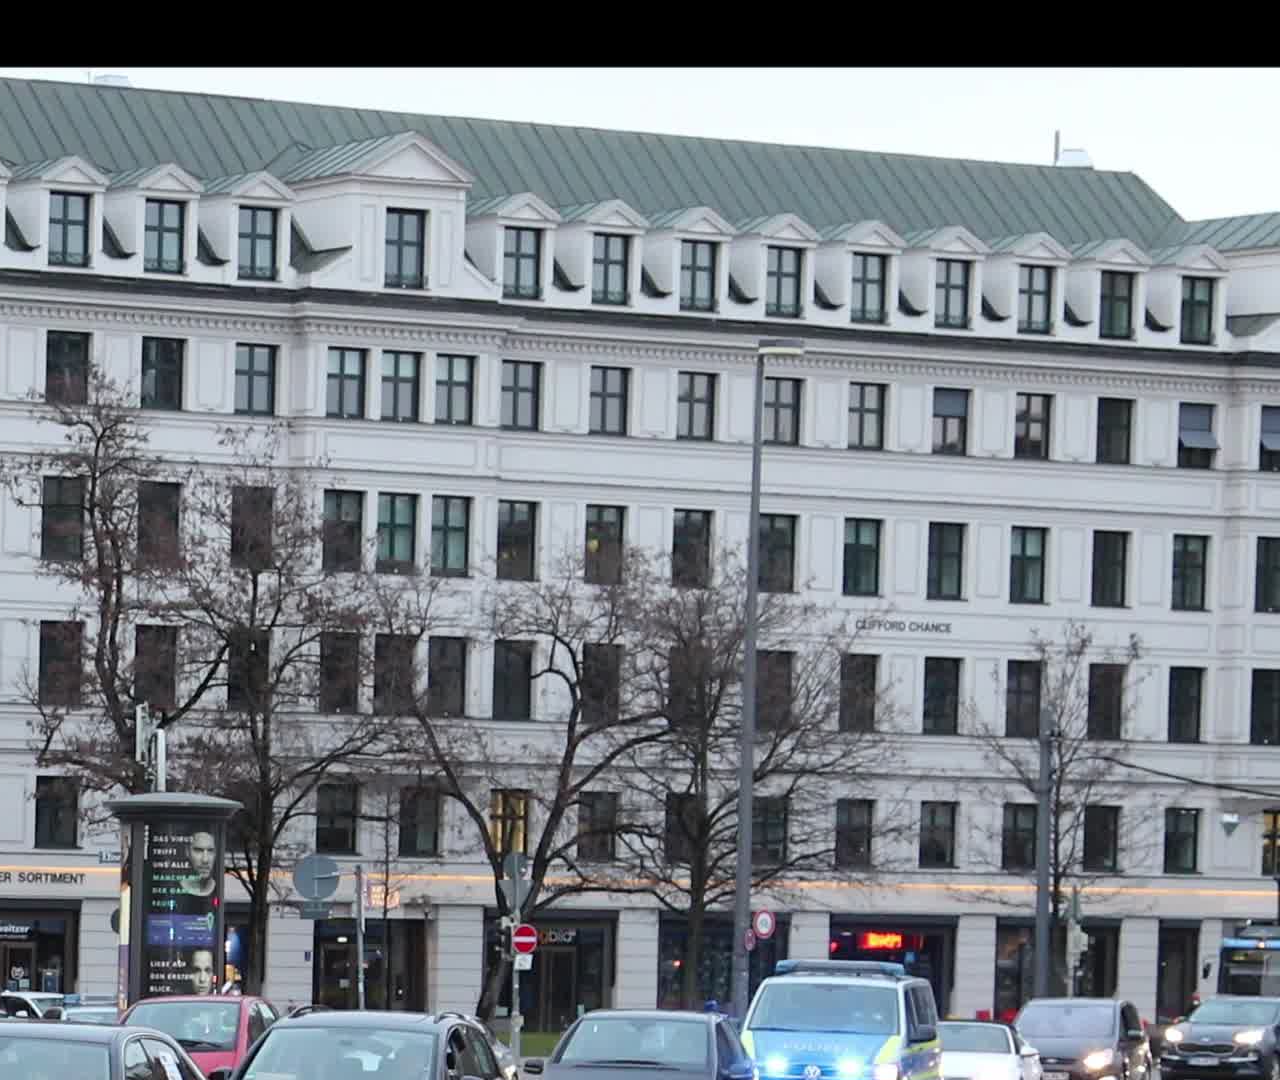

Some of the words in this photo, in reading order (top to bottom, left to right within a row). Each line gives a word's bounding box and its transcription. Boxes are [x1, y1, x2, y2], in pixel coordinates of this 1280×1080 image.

[855, 619, 906, 632] CLIFFORD
[908, 621, 953, 633] CHANCE
[18, 872, 85, 885] SORTIMENT
